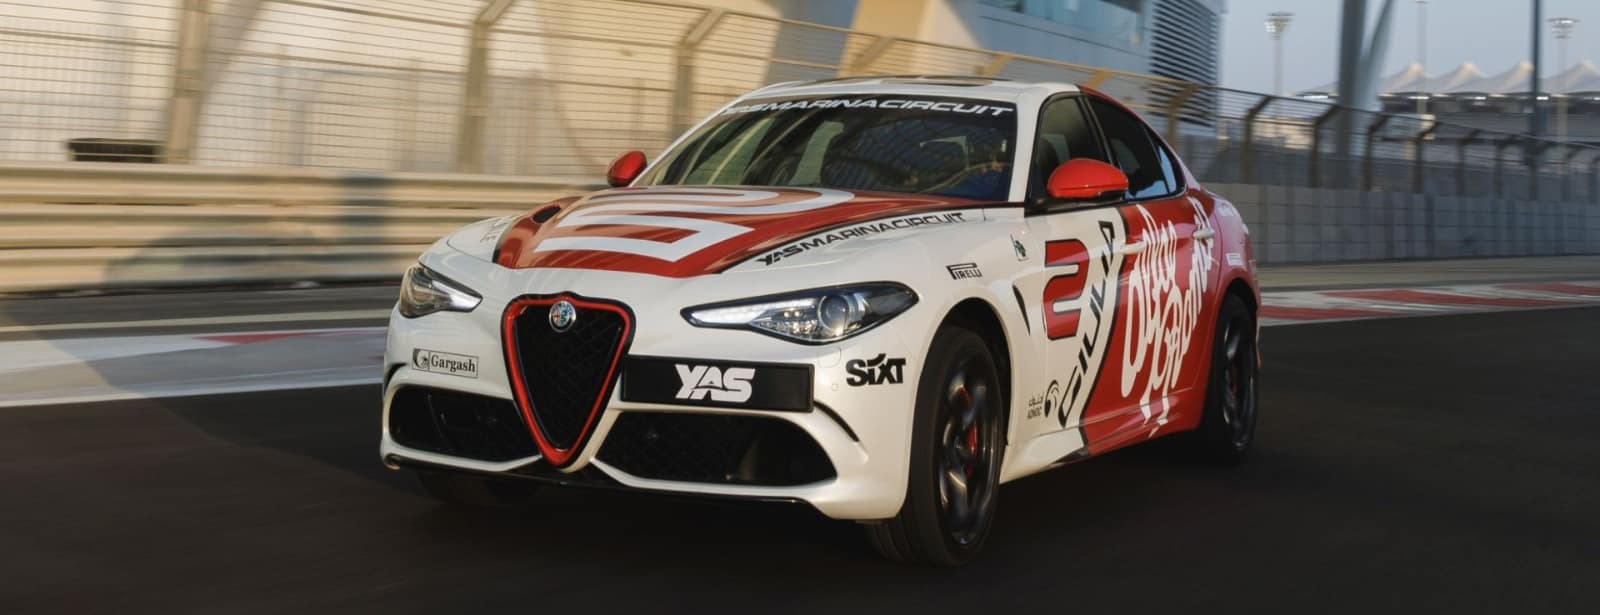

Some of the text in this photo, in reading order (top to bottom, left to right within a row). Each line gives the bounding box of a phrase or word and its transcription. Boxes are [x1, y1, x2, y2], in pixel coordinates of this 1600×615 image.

[945, 262, 983, 280] PIRELLI
[431, 354, 476, 373] Gargash
[674, 363, 756, 403] YAS
